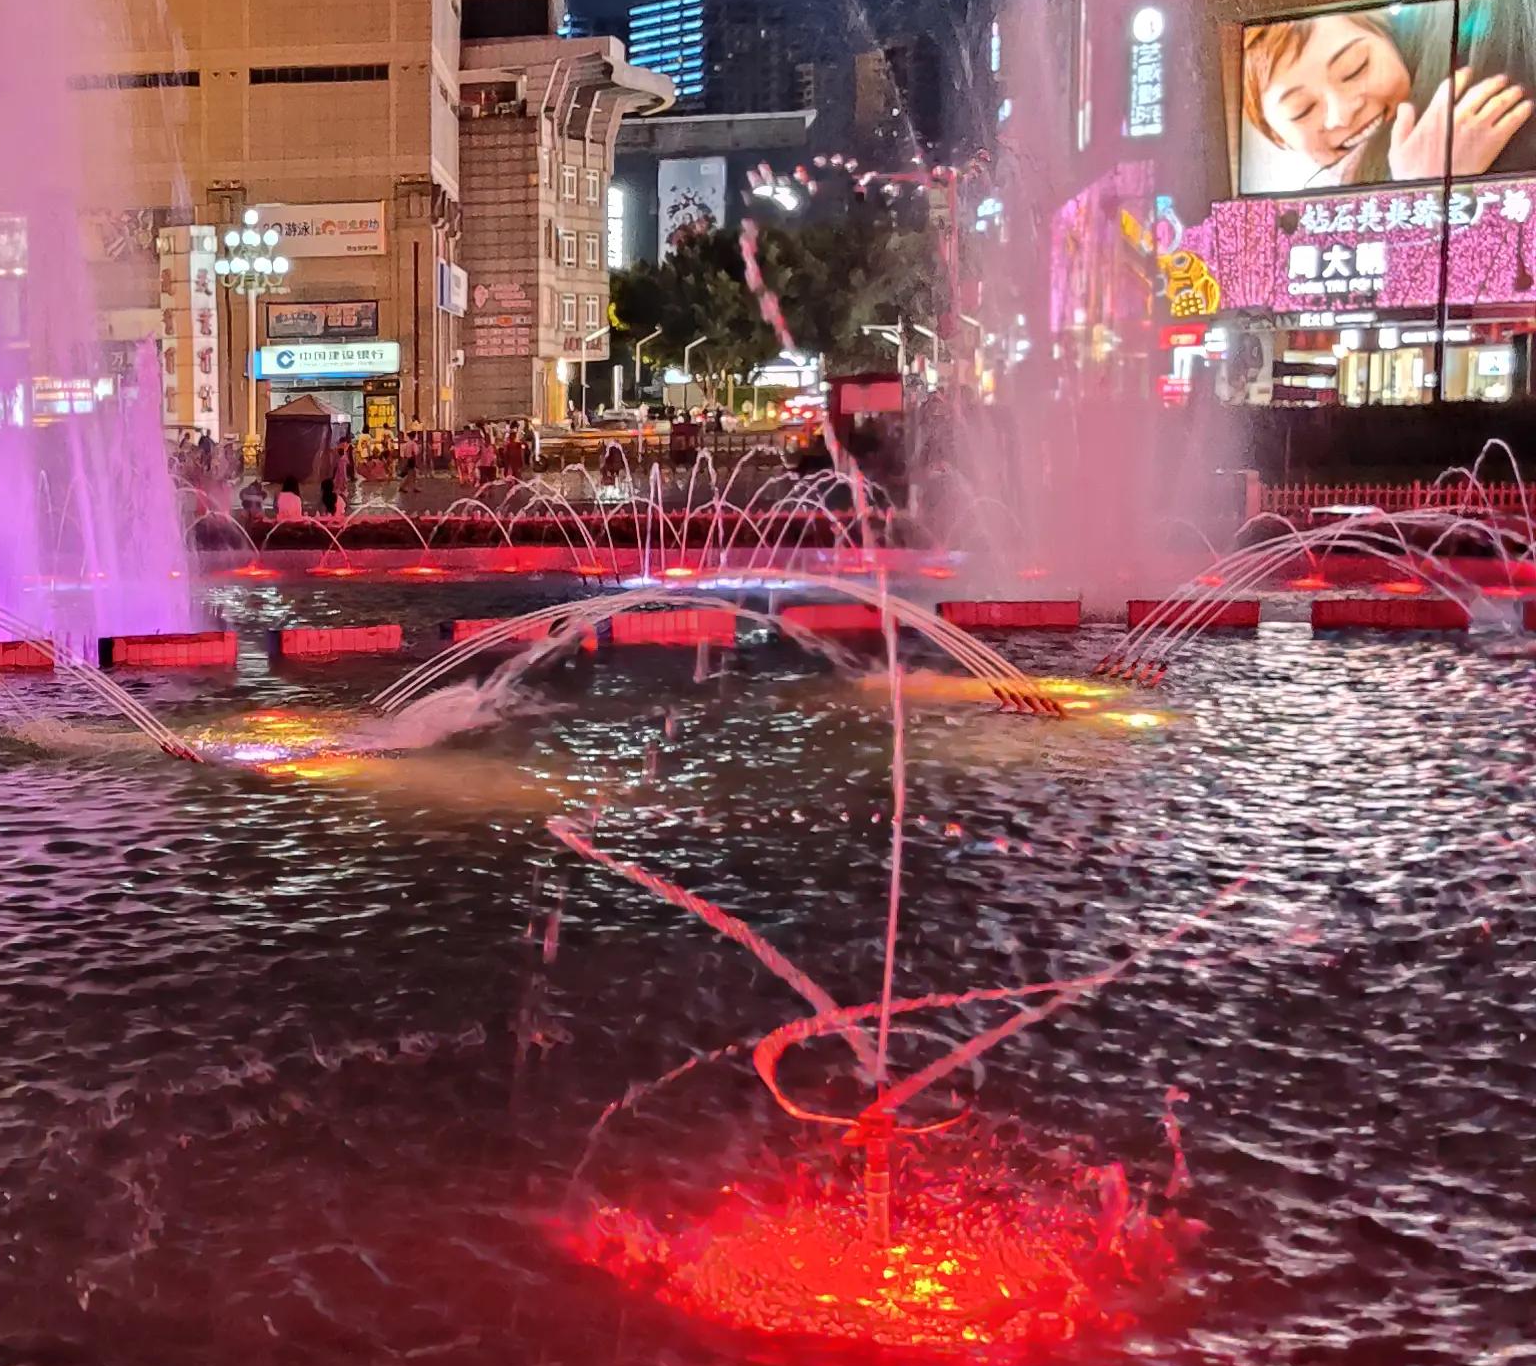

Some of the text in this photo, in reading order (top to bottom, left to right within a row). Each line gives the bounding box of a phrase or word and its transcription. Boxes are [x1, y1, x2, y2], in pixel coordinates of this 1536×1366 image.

[299, 348, 384, 362] 中国建设银行
